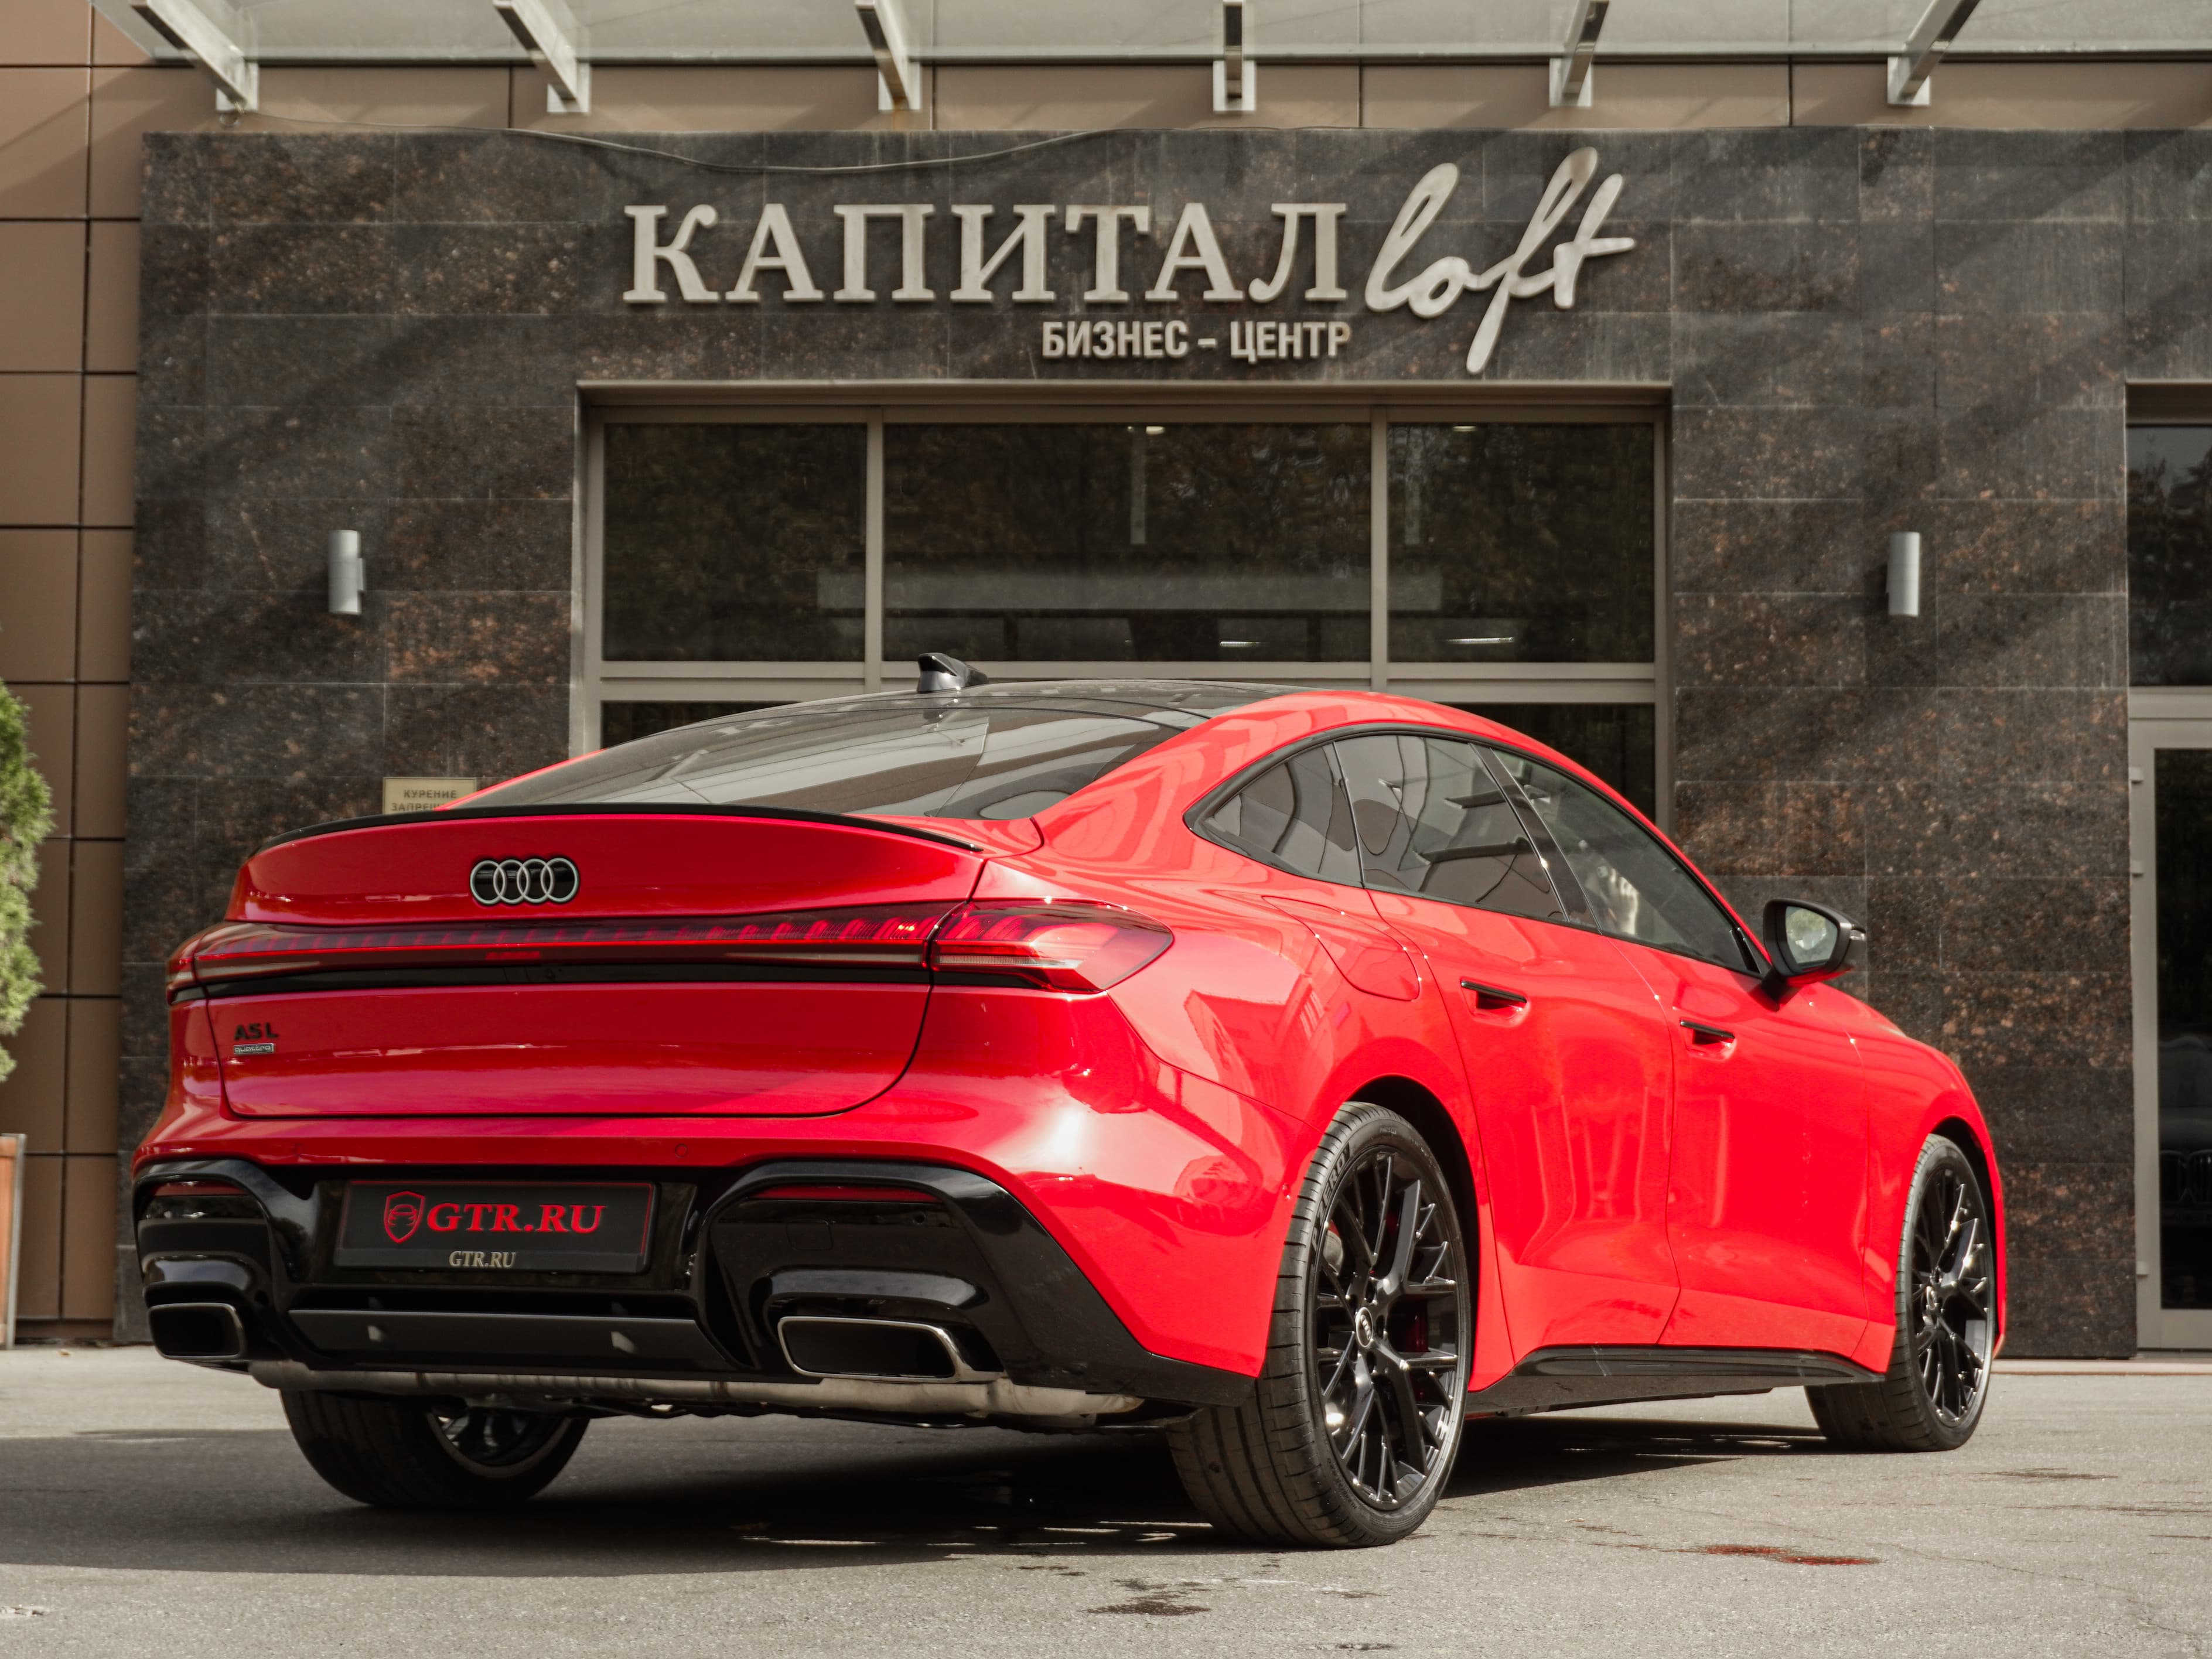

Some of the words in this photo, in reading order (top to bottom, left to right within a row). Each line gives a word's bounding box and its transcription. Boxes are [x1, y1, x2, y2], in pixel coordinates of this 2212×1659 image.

[623, 202, 1347, 302] КАПИТАЛ
[1365, 146, 1636, 374] loft
[1042, 320, 1189, 359] БИЗНЕС
[1230, 320, 1350, 364] ЦЕНТР
[404, 790, 457, 798] КУРЕНИЕ
[391, 803, 444, 811] ЗАПРЕ
[234, 1045, 271, 1054] quattro
[426, 1203, 607, 1234] GTR.RU
[449, 1251, 516, 1269] GTR.RU
